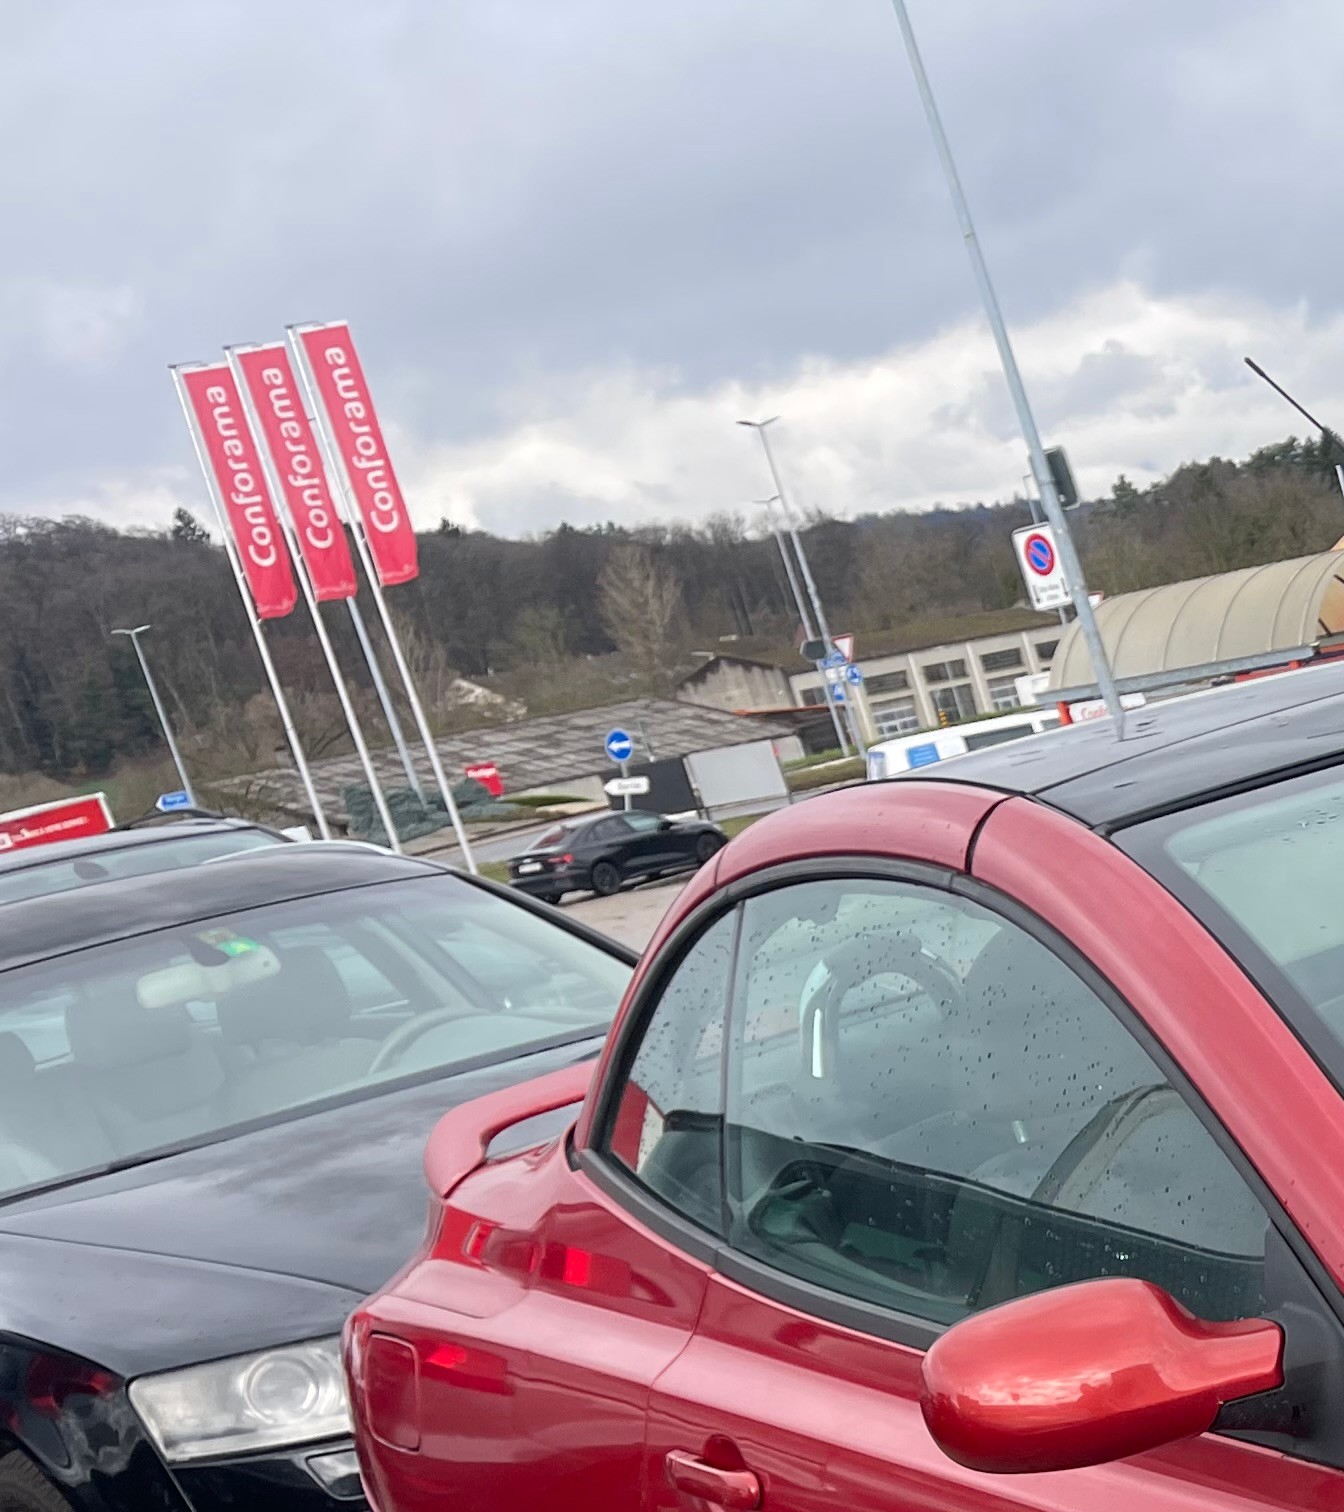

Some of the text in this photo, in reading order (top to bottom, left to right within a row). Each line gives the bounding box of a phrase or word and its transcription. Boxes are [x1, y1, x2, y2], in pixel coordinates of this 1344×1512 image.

[206, 385, 277, 567] Conforama
[262, 367, 335, 549] Conforama
[325, 346, 399, 533] Conforama
